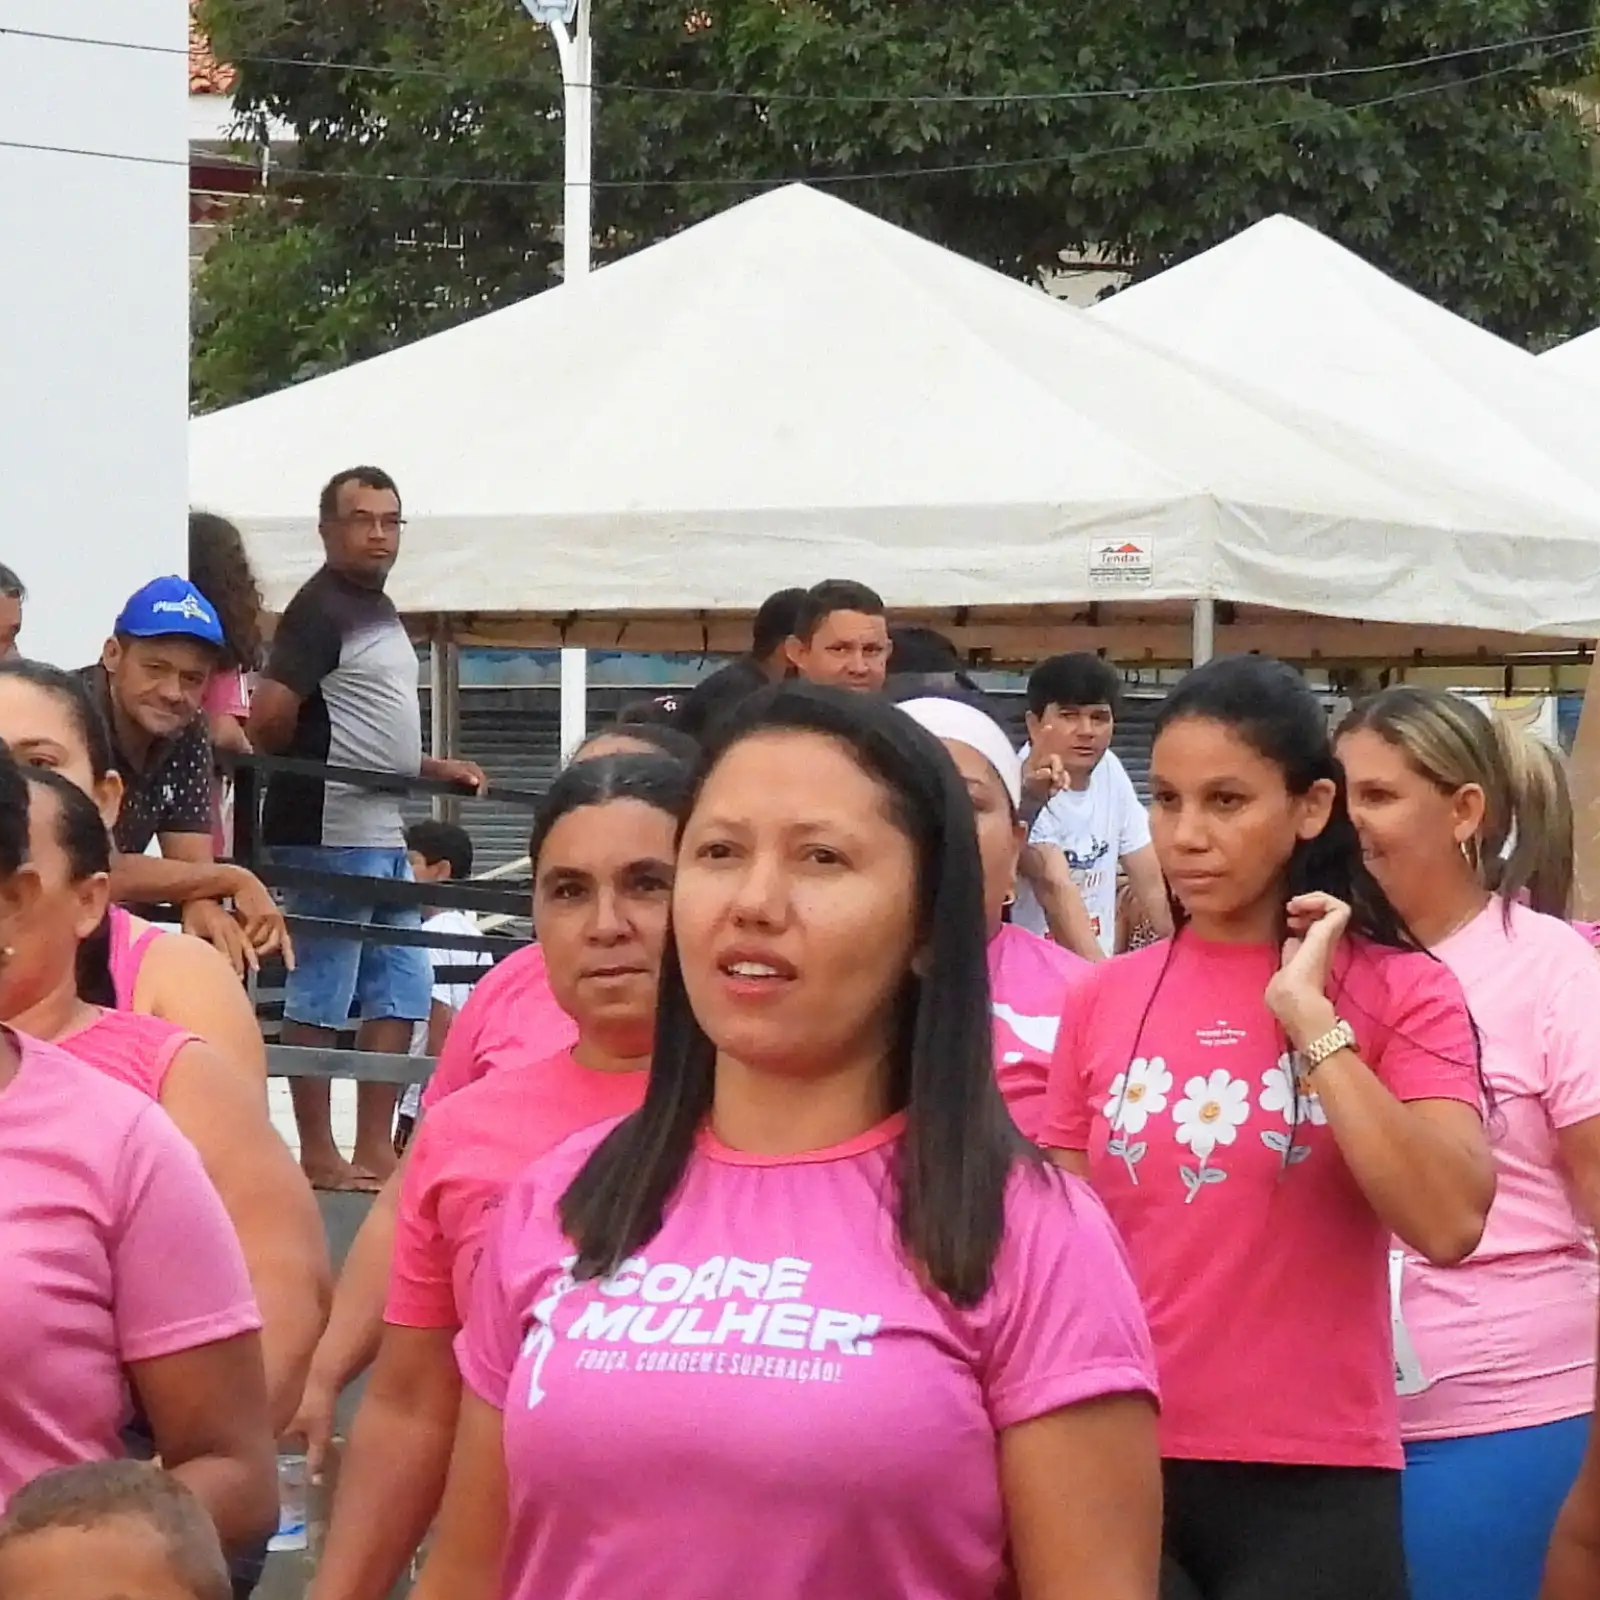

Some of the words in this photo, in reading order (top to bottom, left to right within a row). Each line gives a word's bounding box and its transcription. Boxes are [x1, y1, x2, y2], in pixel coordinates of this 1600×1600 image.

[600, 1255, 812, 1303] CORRE
[567, 1301, 883, 1356] MULHER!
[634, 1349, 714, 1373] CORAGEM
